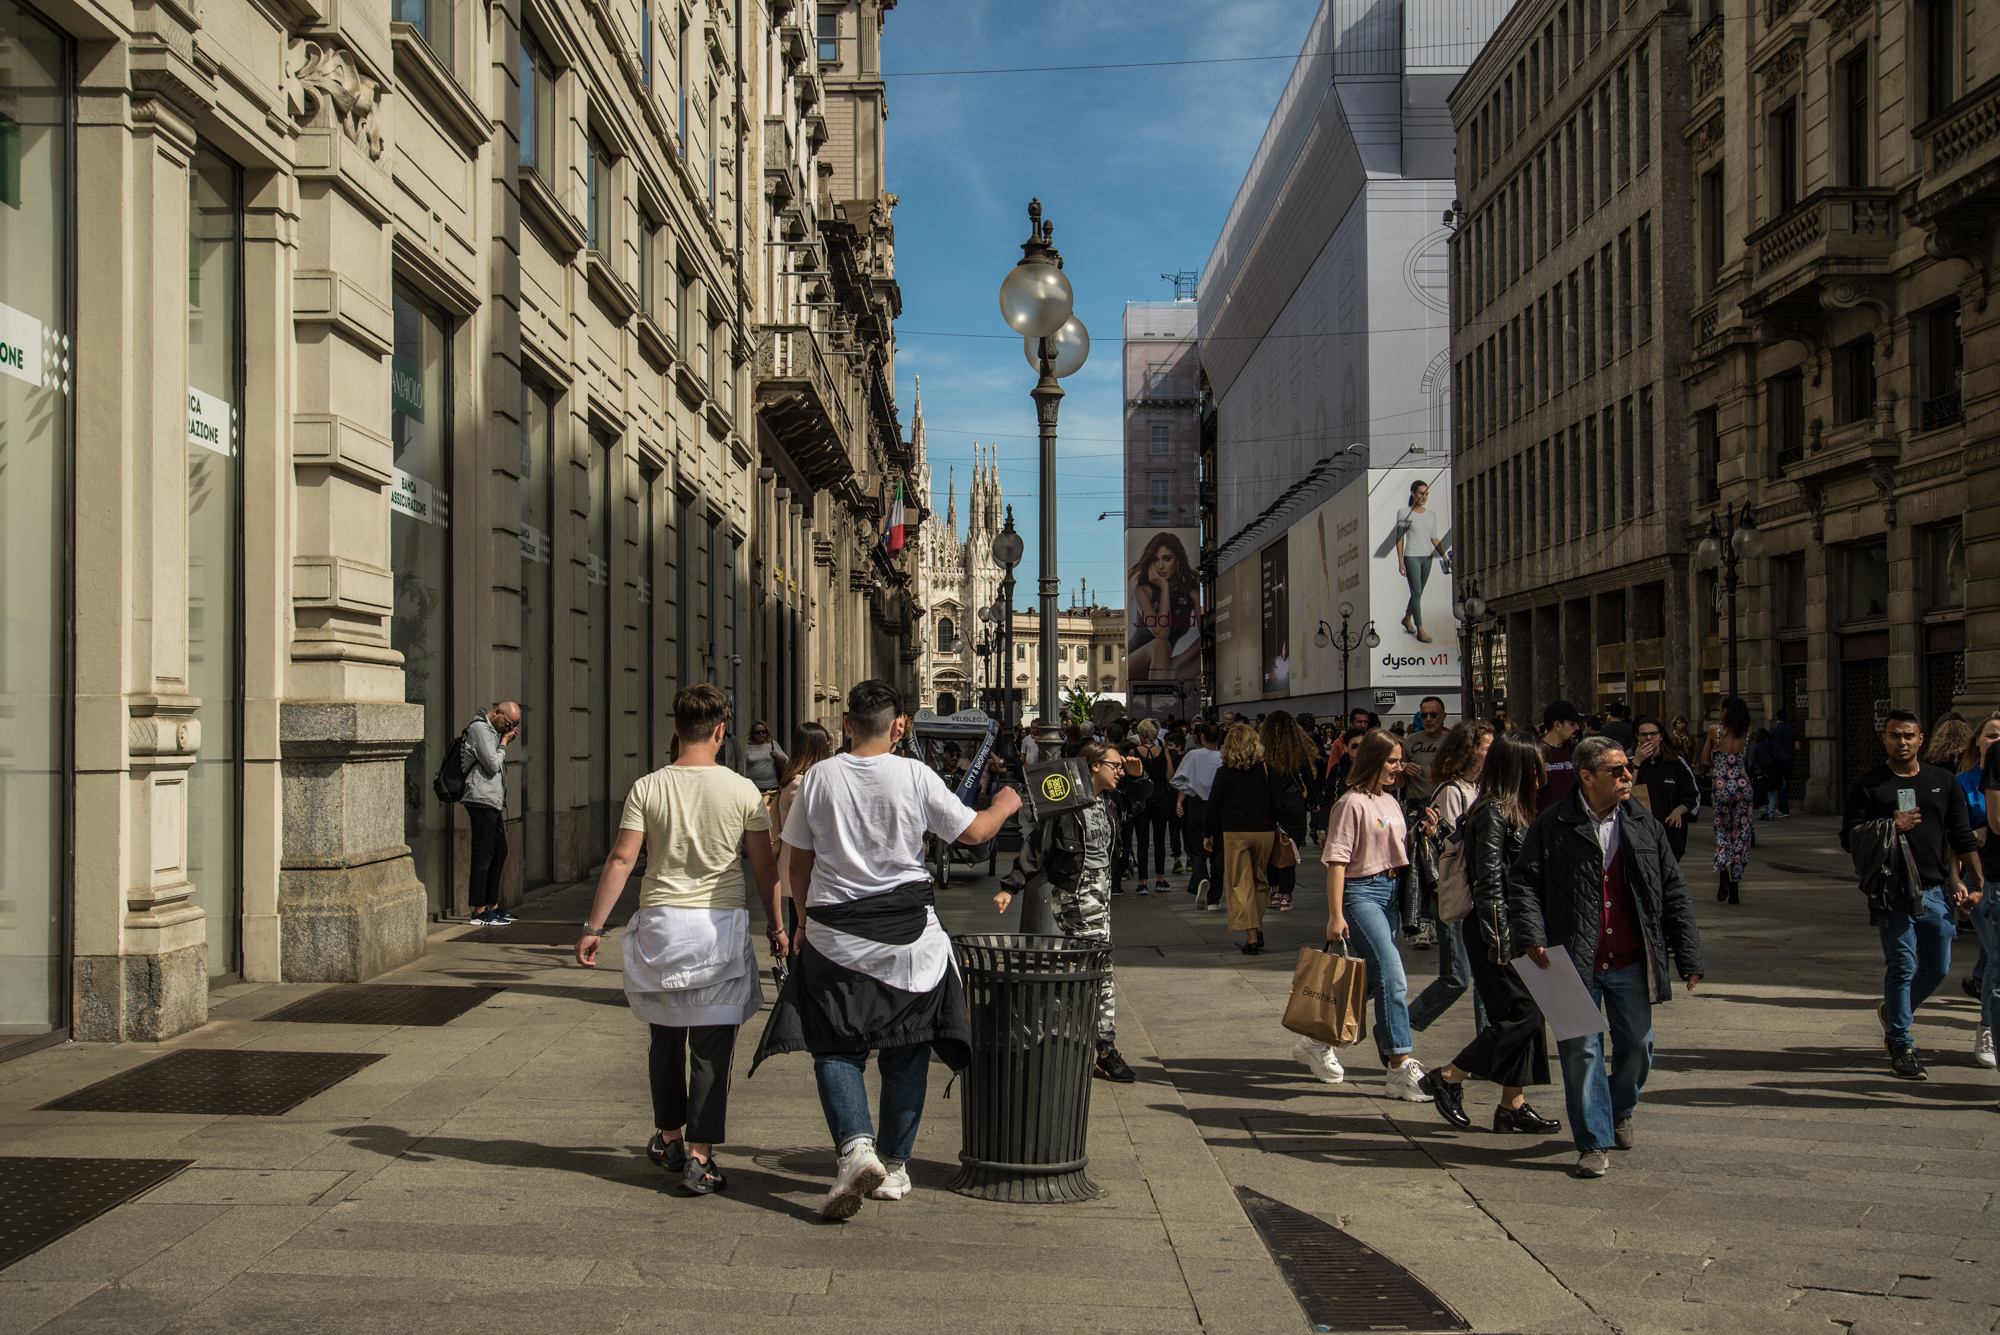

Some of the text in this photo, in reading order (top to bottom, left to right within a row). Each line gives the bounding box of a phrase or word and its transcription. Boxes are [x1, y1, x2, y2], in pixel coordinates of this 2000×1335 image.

[188, 394, 202, 415] CA
[401, 476, 418, 496] BANCA
[1133, 611, 1196, 628] Jadea
[1382, 653, 1425, 670] dyson
[1430, 654, 1448, 666] v11
[965, 773, 976, 788] CITY
[975, 745, 990, 770] SHOPPING
[1051, 776, 1064, 797] STORE
[1302, 986, 1337, 1005] Bershka
